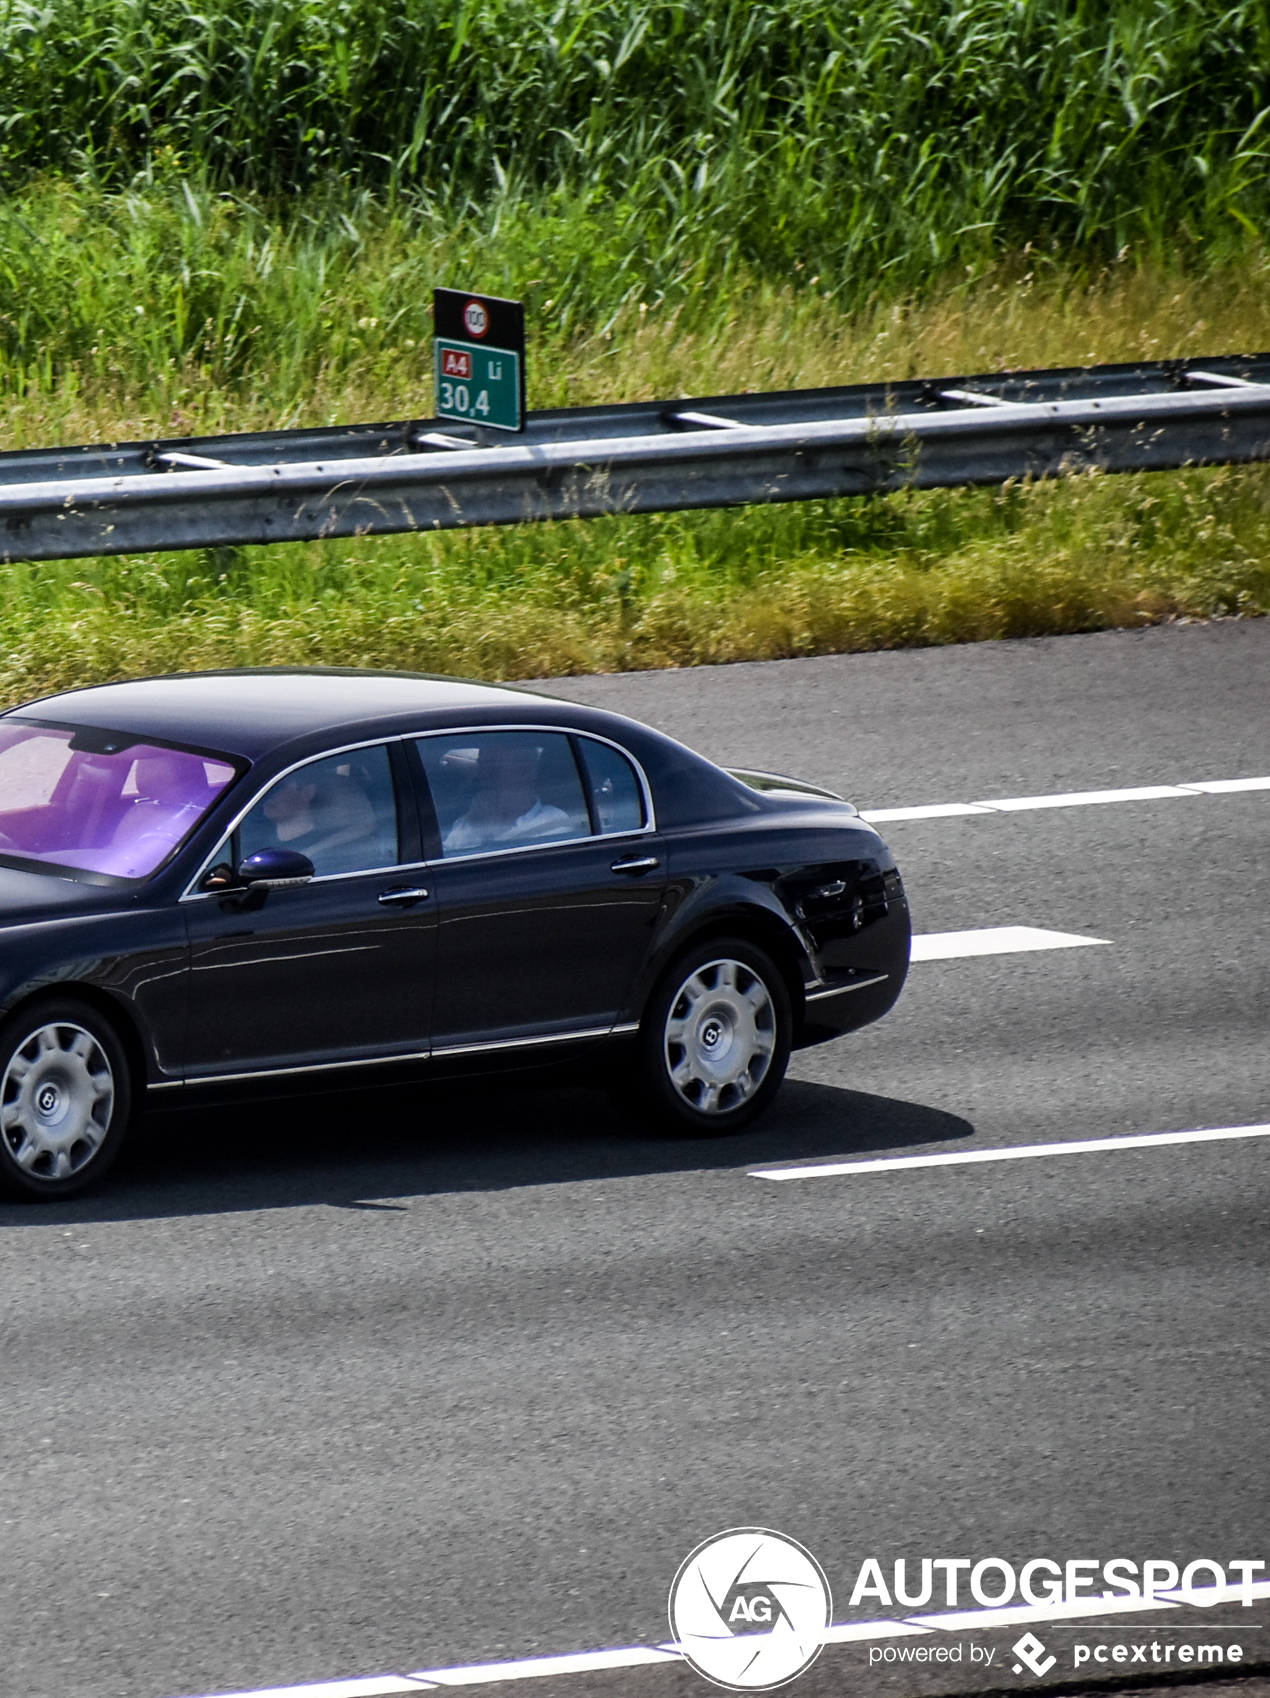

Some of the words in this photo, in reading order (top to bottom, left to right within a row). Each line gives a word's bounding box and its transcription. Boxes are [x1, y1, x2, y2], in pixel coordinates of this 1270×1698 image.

[466, 310, 486, 327] 100
[445, 354, 468, 375] A4
[488, 361, 502, 380] Li
